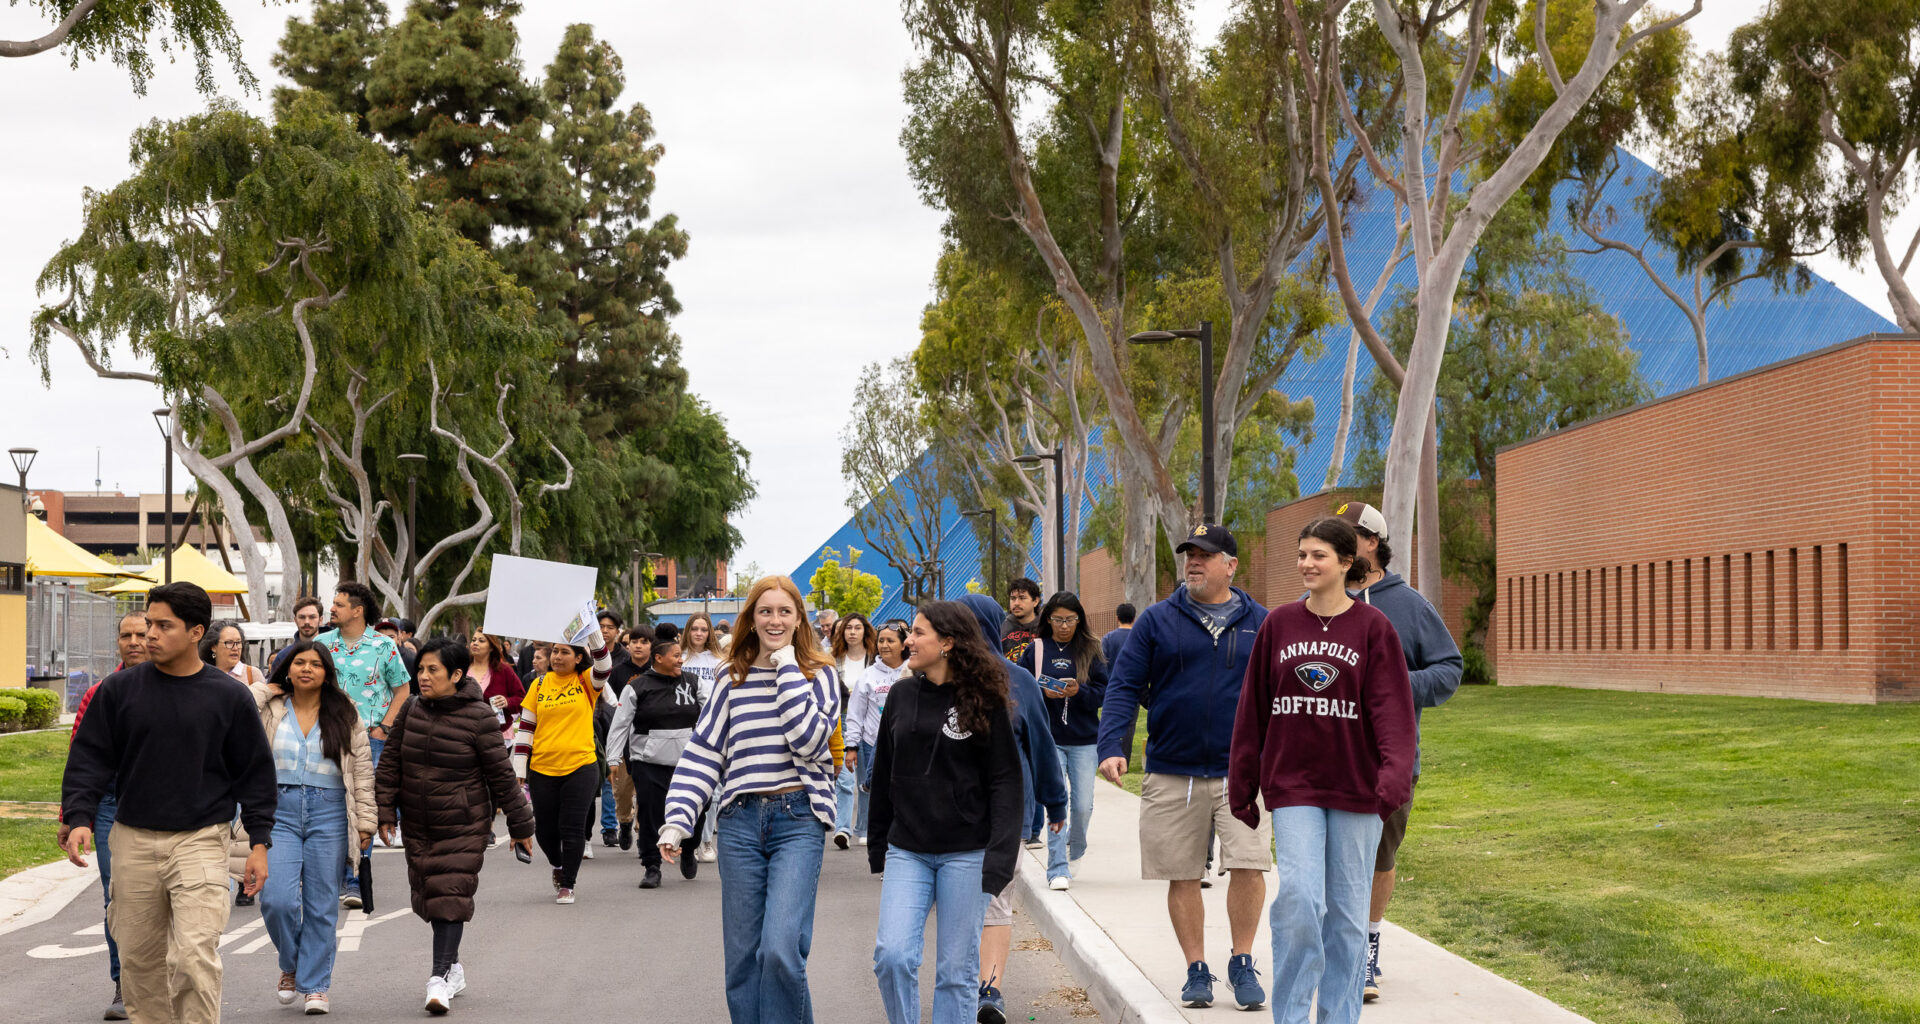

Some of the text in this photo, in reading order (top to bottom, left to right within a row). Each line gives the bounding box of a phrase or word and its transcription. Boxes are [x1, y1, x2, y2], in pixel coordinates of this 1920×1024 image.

[1279, 641, 1360, 667] ANNAPOLIS
[675, 682, 696, 706] NY
[1271, 696, 1359, 720] SOFTBALL
